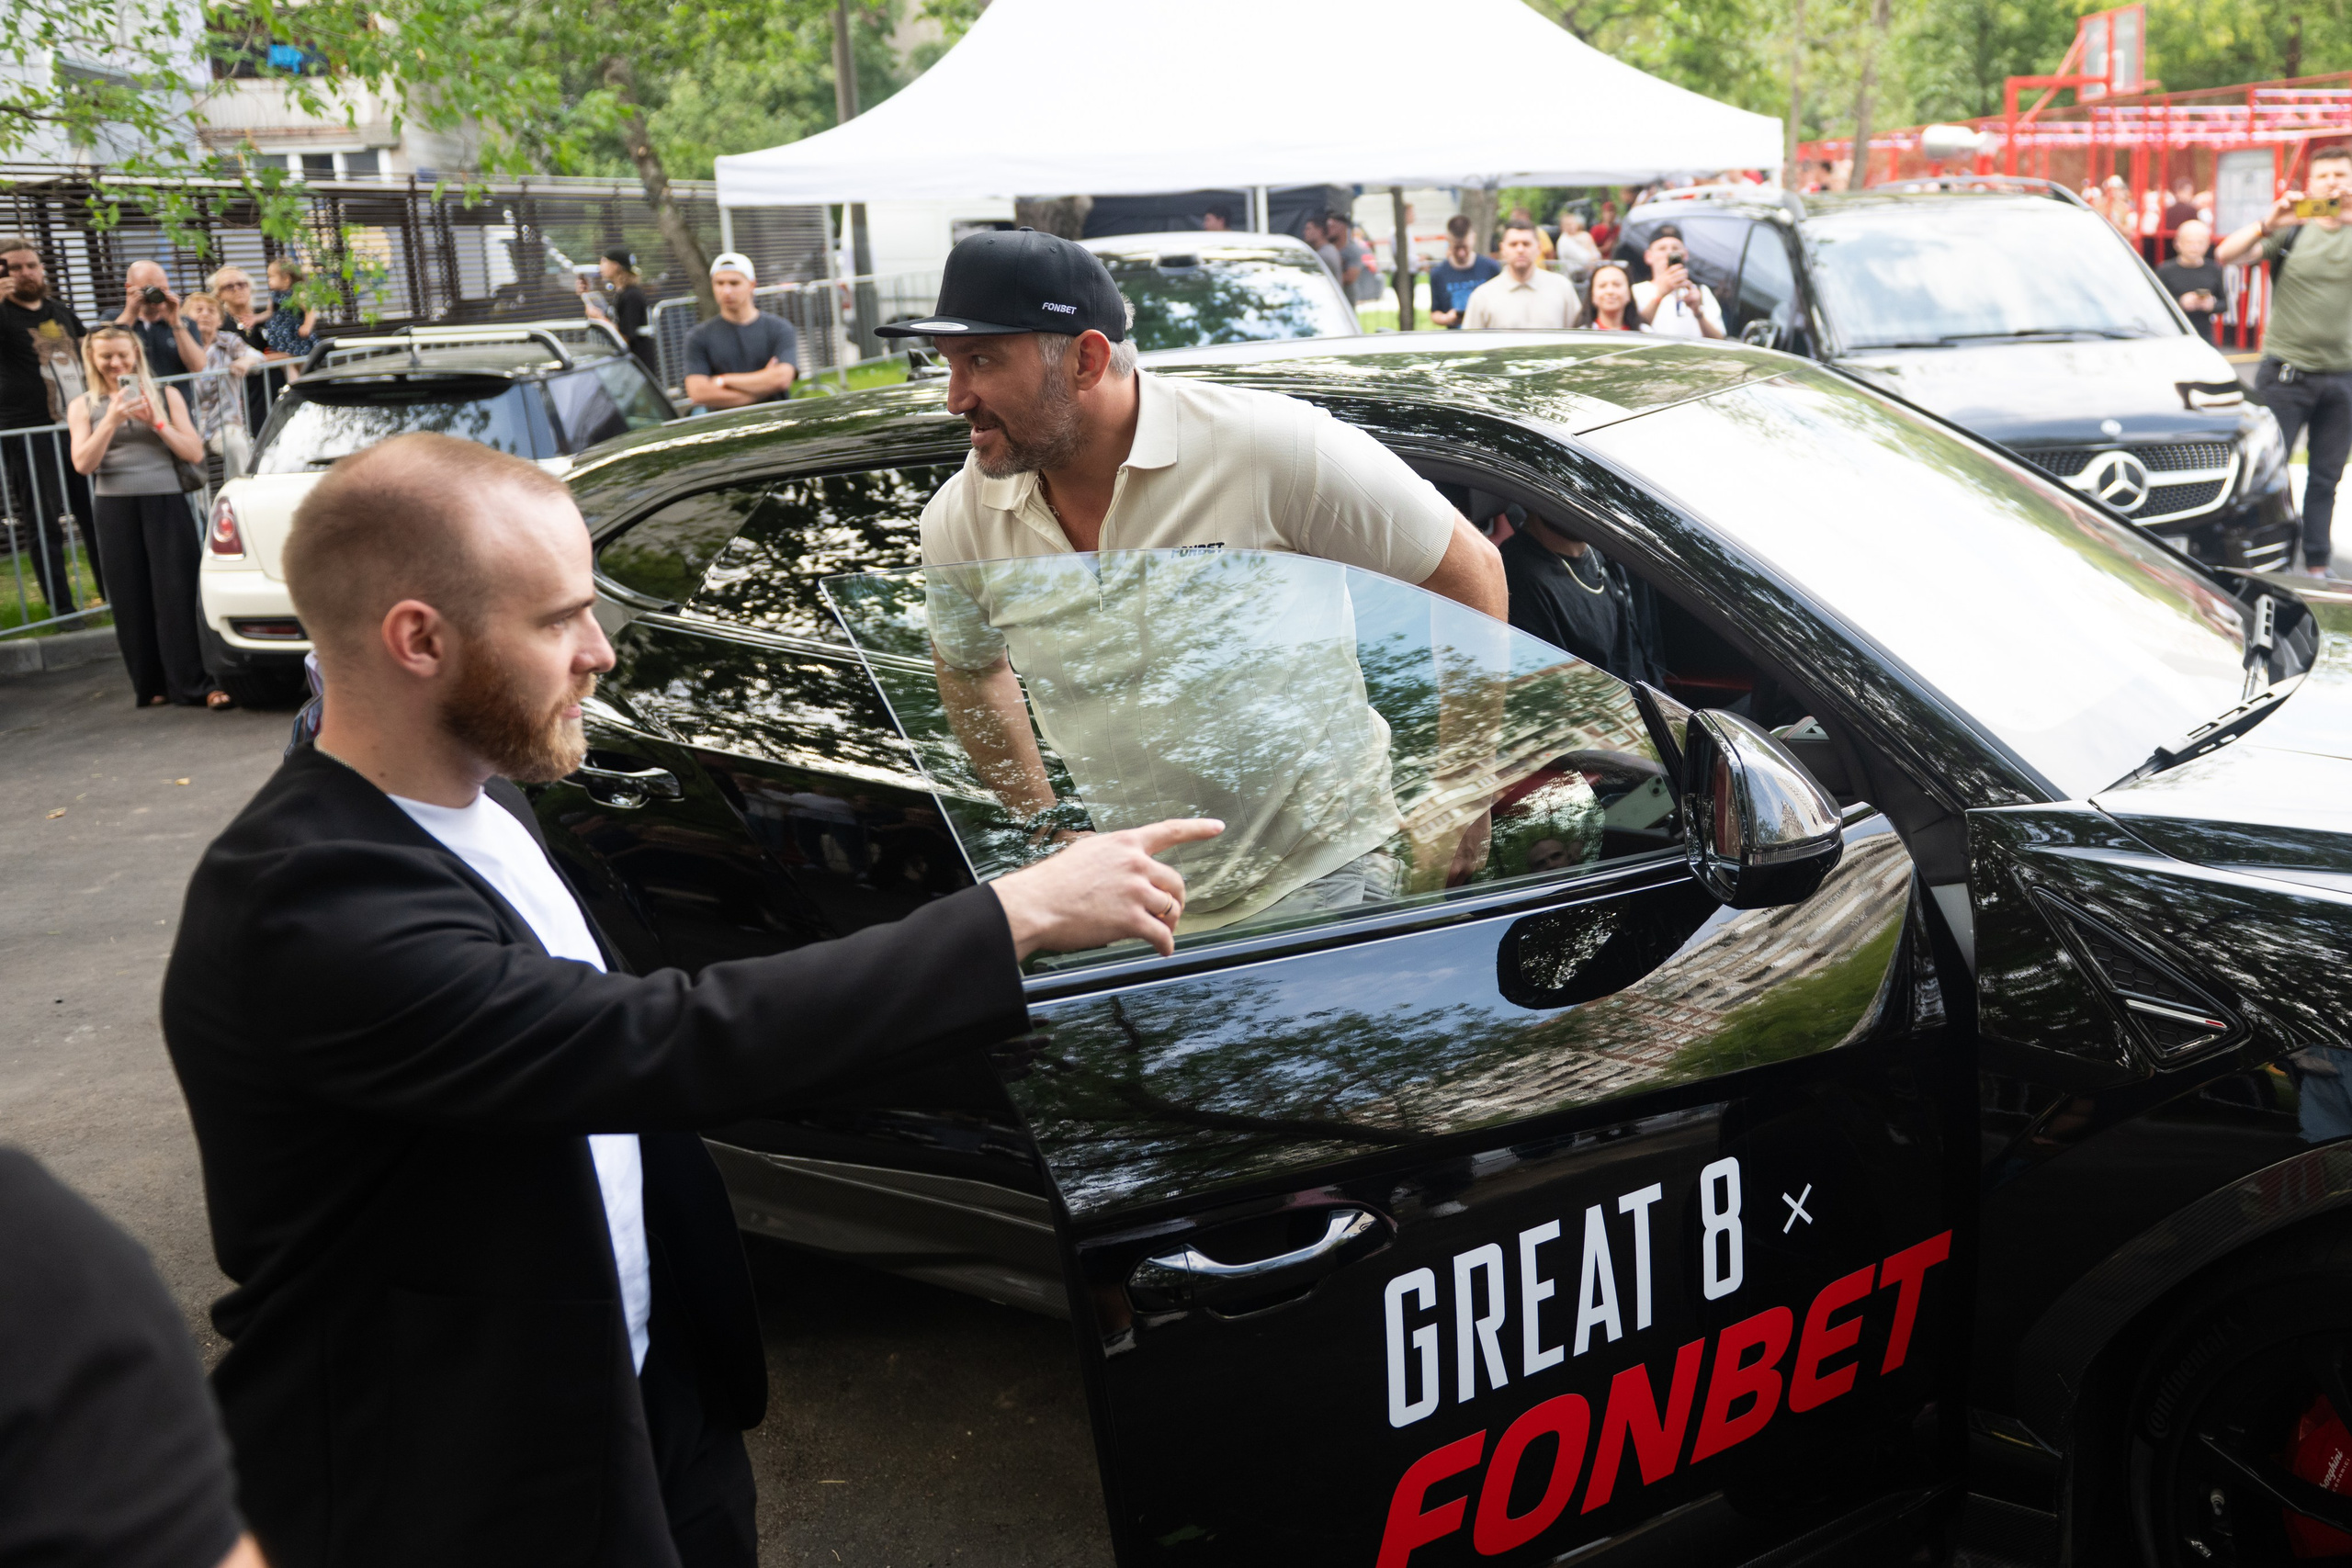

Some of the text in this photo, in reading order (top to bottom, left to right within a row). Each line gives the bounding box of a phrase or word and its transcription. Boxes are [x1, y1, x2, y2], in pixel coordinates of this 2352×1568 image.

[1042, 301, 1077, 315] FONBET
[1375, 1229, 1953, 1568] FONBET
[1384, 1181, 1662, 1428] GREAT
[1700, 1156, 1744, 1302] 8
